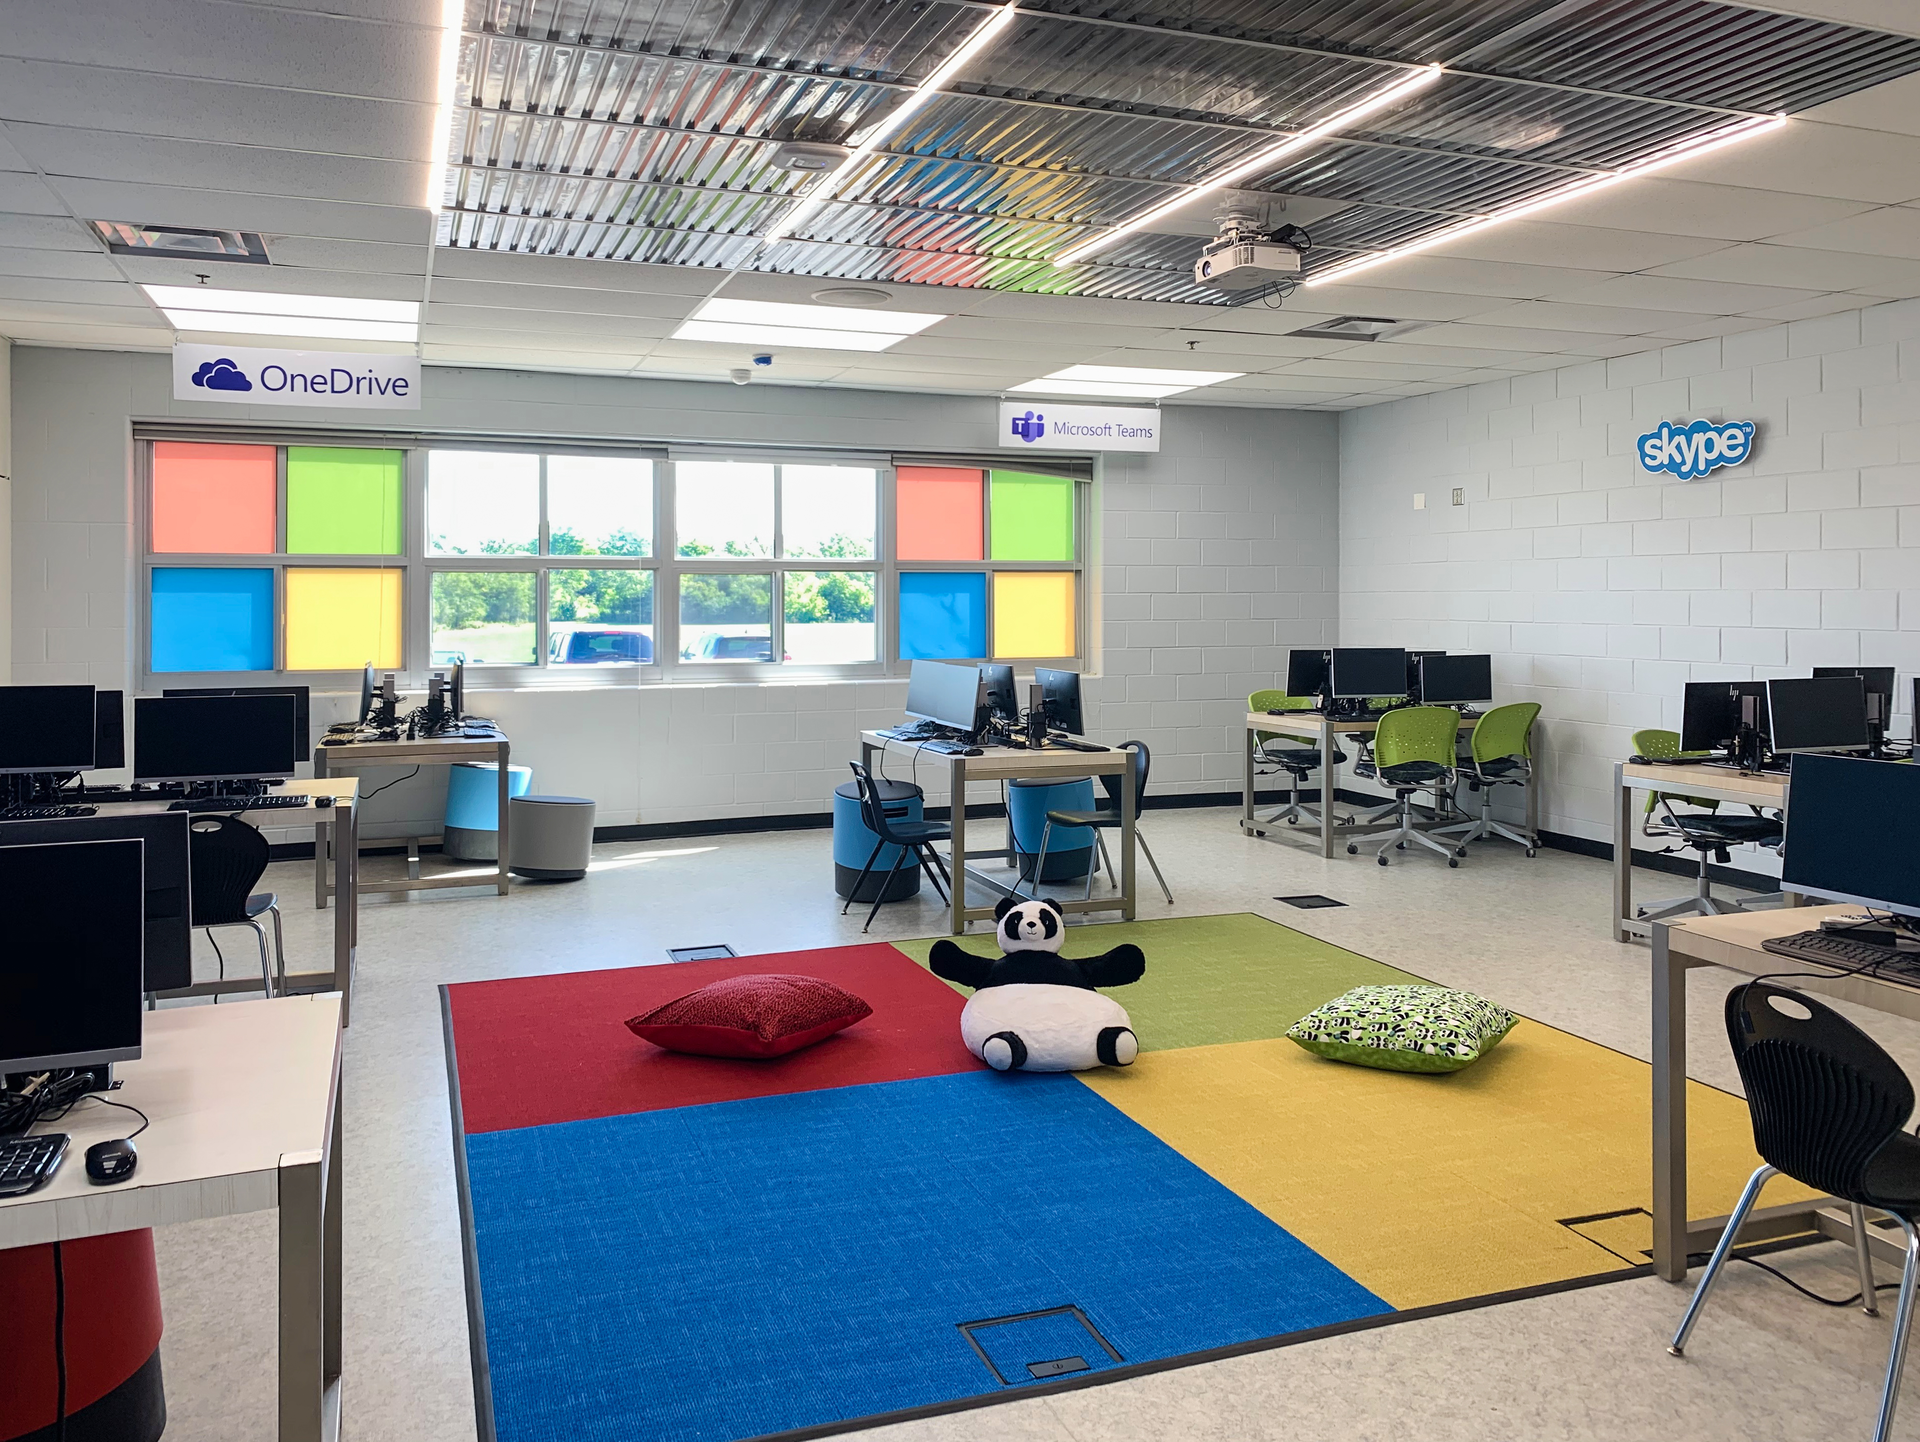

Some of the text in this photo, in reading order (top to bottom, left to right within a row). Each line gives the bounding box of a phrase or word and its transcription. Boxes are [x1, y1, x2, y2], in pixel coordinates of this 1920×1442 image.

[260, 365, 409, 396] OneDrive
[1053, 421, 1112, 437] Microsoft
[1115, 423, 1153, 439] Teams
[1644, 427, 1745, 472] skype
[1729, 684, 1739, 701] hp
[9, 1137, 42, 1145] Microsoft
